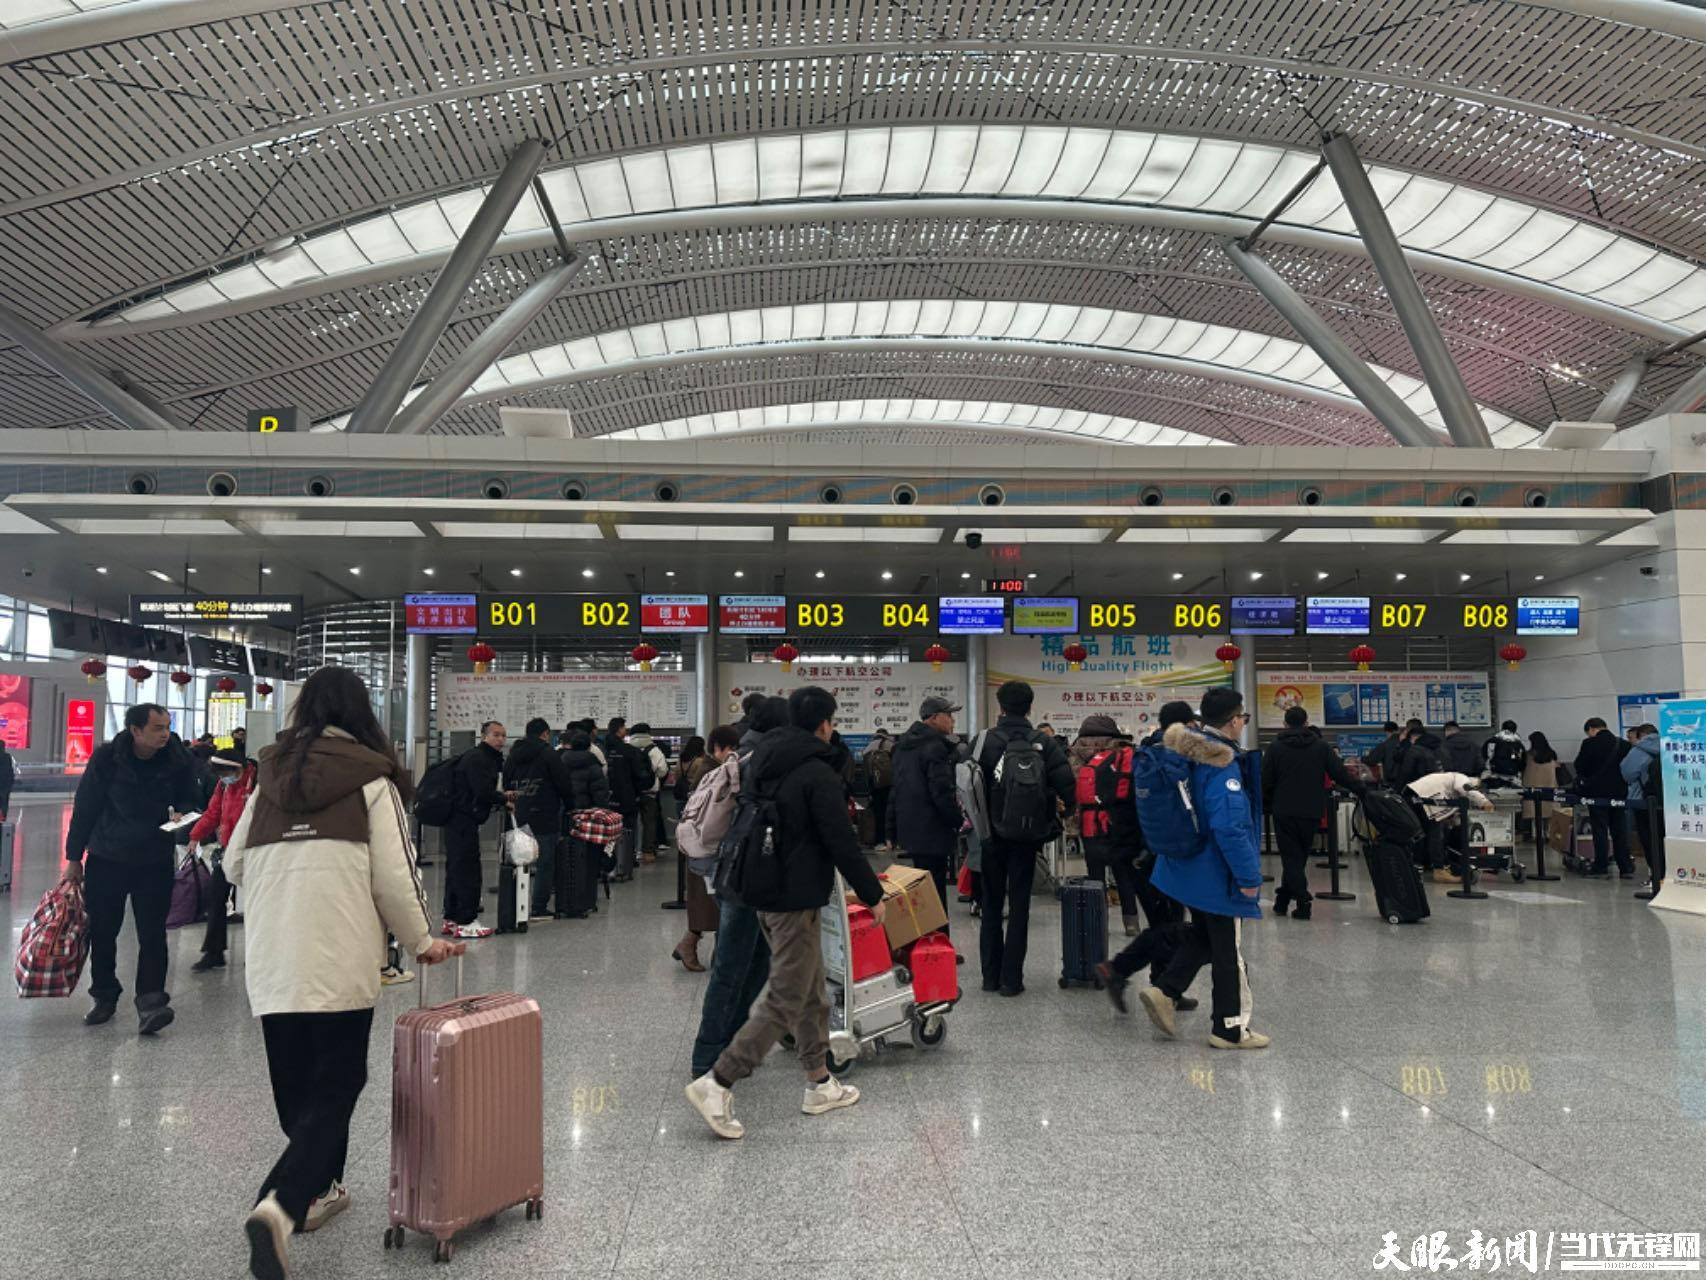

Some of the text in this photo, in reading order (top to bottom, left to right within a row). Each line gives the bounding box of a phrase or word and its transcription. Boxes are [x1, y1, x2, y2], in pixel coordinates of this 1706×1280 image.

[259, 415, 279, 434] D
[490, 602, 536, 626] B01
[582, 602, 630, 626] B02
[659, 606, 691, 619] 团队
[798, 603, 844, 627] B03
[883, 603, 930, 627] B04
[1090, 604, 1136, 627] B05
[1175, 604, 1221, 627] B06
[1382, 604, 1427, 627] B07
[1463, 604, 1508, 627] B08
[1041, 634, 1172, 656] 精品航班
[797, 666, 893, 677] 办理以下航空公司
[1080, 661, 1129, 674] Quality
[1133, 661, 1174, 674] Flight
[1062, 692, 1157, 702] 办理以下航空公司
